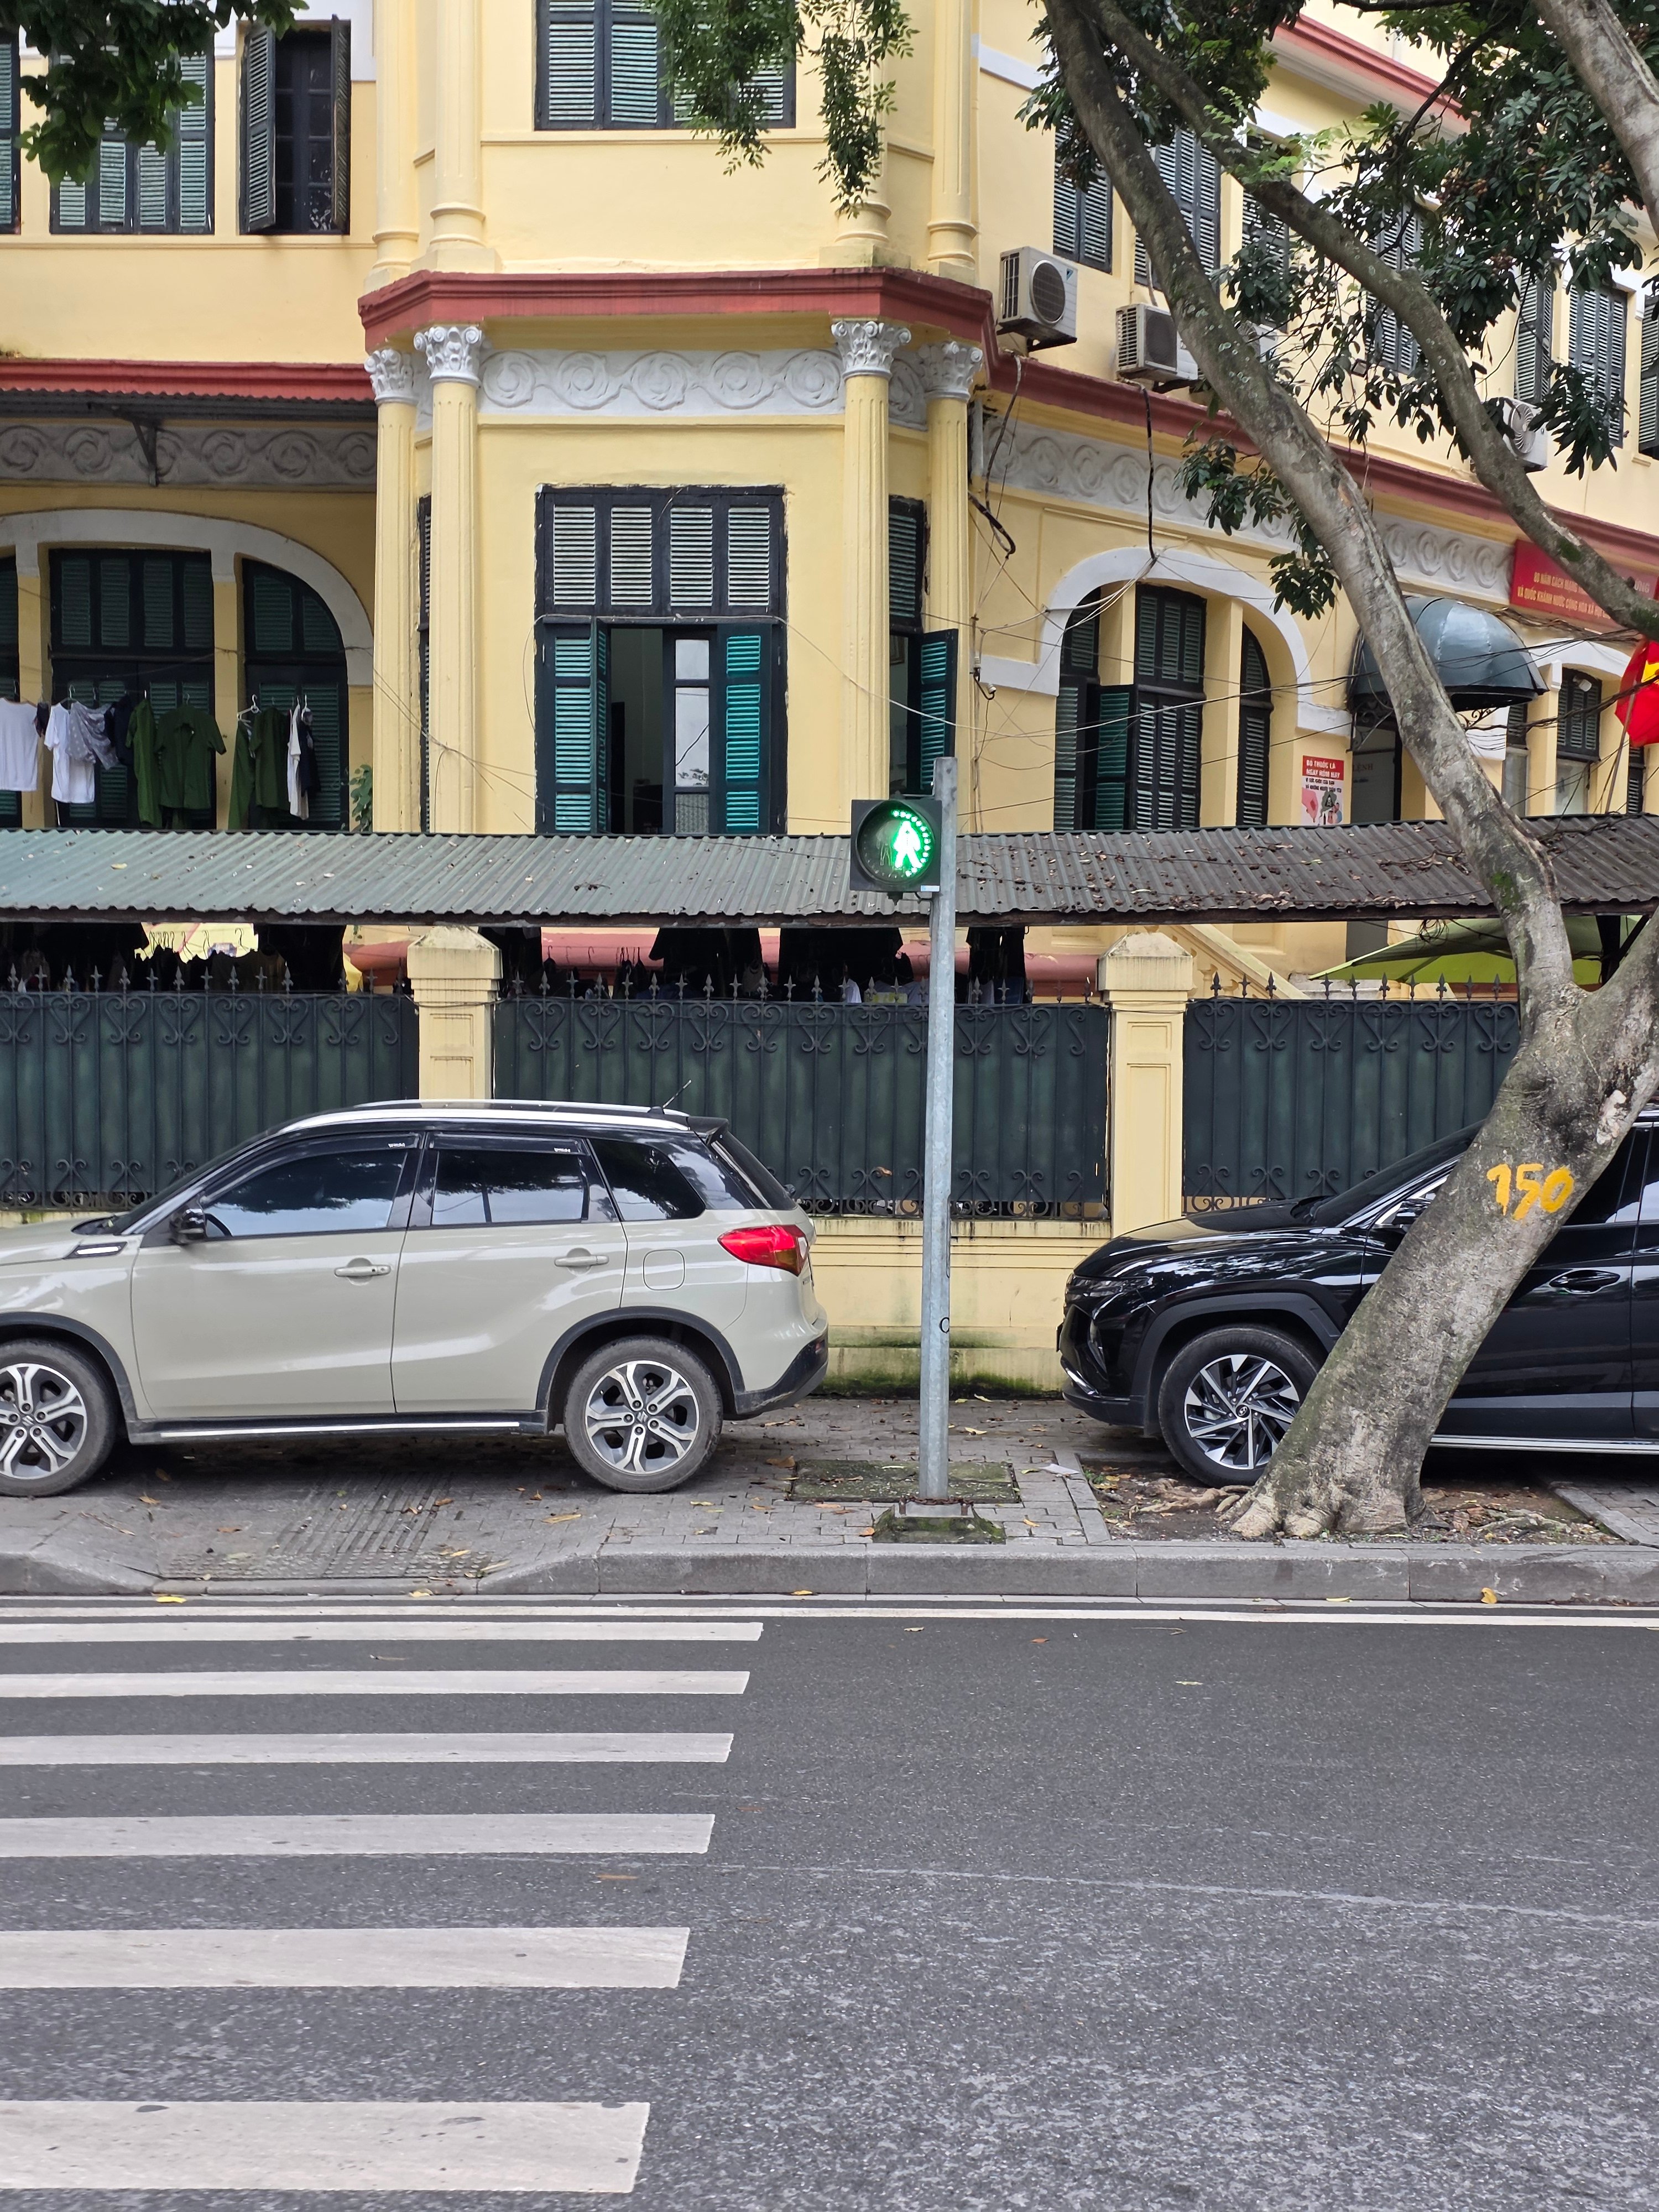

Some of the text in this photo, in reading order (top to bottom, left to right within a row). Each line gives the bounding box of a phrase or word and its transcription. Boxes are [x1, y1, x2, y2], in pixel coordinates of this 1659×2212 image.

[1533, 572, 1540, 583] 80
[1537, 590, 1553, 604] KHÁNH
[1306, 759, 1313, 767] BỎ
[1314, 760, 1329, 768] THUỐC
[1486, 1162, 1575, 1221] 150
